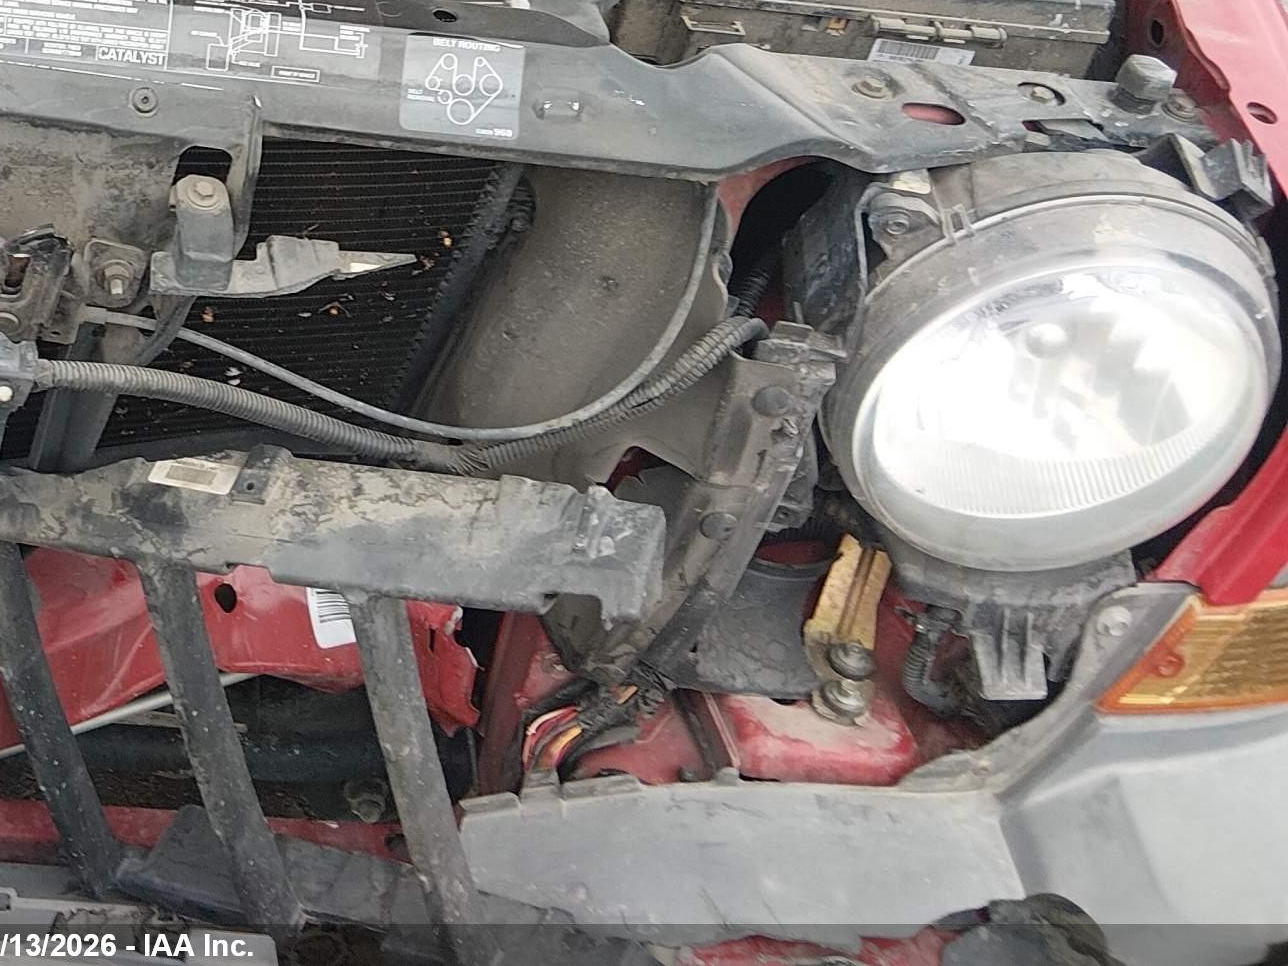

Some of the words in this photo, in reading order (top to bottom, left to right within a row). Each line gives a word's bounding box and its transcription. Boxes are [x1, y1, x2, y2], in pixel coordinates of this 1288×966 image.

[433, 37, 457, 48] BELT
[457, 40, 501, 52] ROUTING
[98, 47, 165, 66] CATALYST
